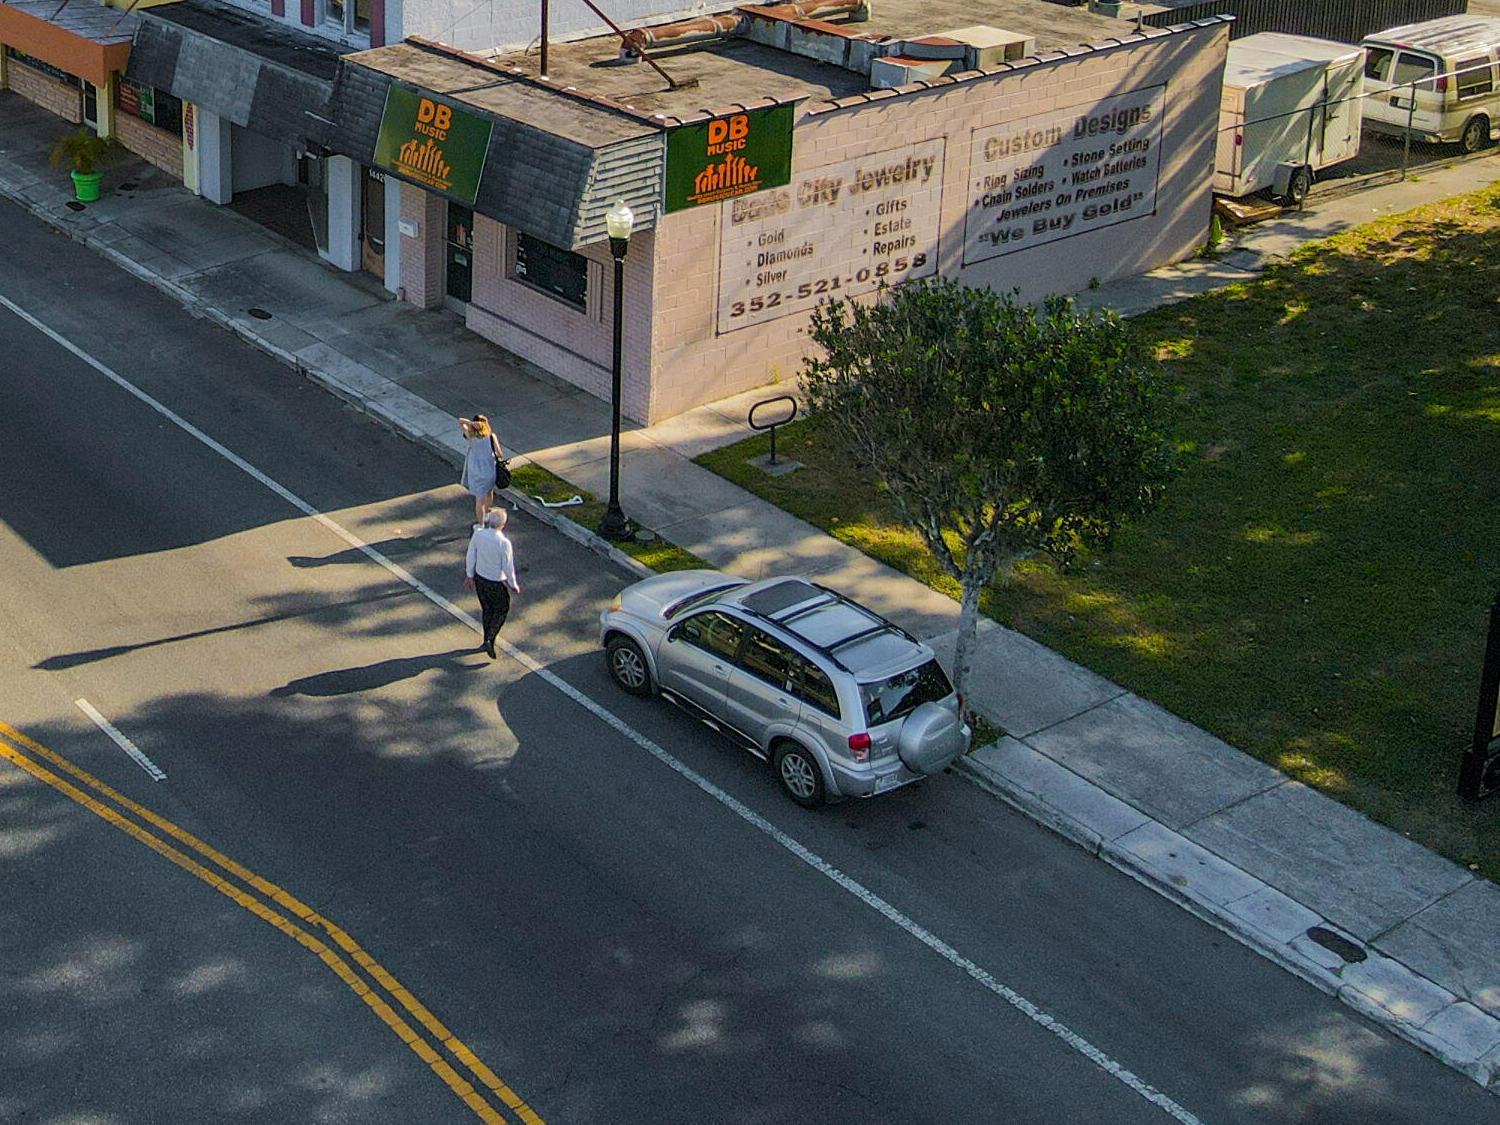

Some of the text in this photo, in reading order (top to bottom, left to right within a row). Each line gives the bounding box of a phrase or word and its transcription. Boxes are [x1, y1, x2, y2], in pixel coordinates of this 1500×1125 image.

[417, 98, 452, 131] DB
[414, 121, 447, 142] MUSIC
[708, 114, 749, 145] DB
[983, 104, 1151, 162] Custom Designs
[707, 138, 747, 156] MUSIC
[1071, 137, 1150, 168] Stone Setting
[797, 175, 843, 210] City
[850, 153, 936, 196] Jewelry
[983, 163, 1045, 189] Ring Sizing
[1072, 156, 1147, 186] Watch Batteries
[982, 179, 1054, 208] Chain Solders
[996, 178, 1130, 223] Jewelers On Premises
[875, 198, 908, 216] Gifts
[874, 216, 912, 237] Estate
[1032, 212, 1077, 236] Buy
[758, 229, 785, 247] Gold
[873, 234, 916, 257] Repairs
[757, 241, 814, 267] Diamonds
[730, 253, 927, 317] 352-521-0858
[756, 269, 788, 287] Silver
